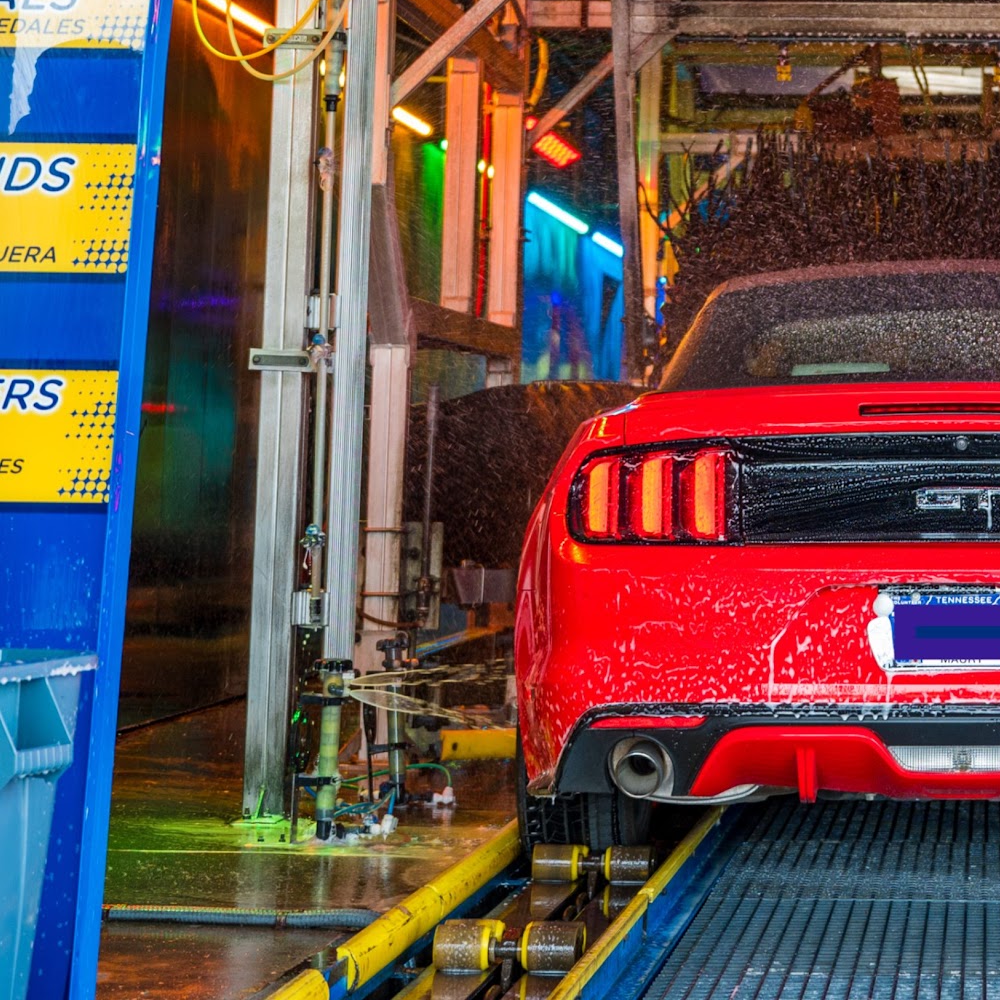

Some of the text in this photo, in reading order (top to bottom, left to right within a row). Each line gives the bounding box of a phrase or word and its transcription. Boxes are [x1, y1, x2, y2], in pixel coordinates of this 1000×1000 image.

[0, 157, 75, 192] DS
[0, 379, 63, 410] RS
[936, 596, 992, 604] TENNESSEE
